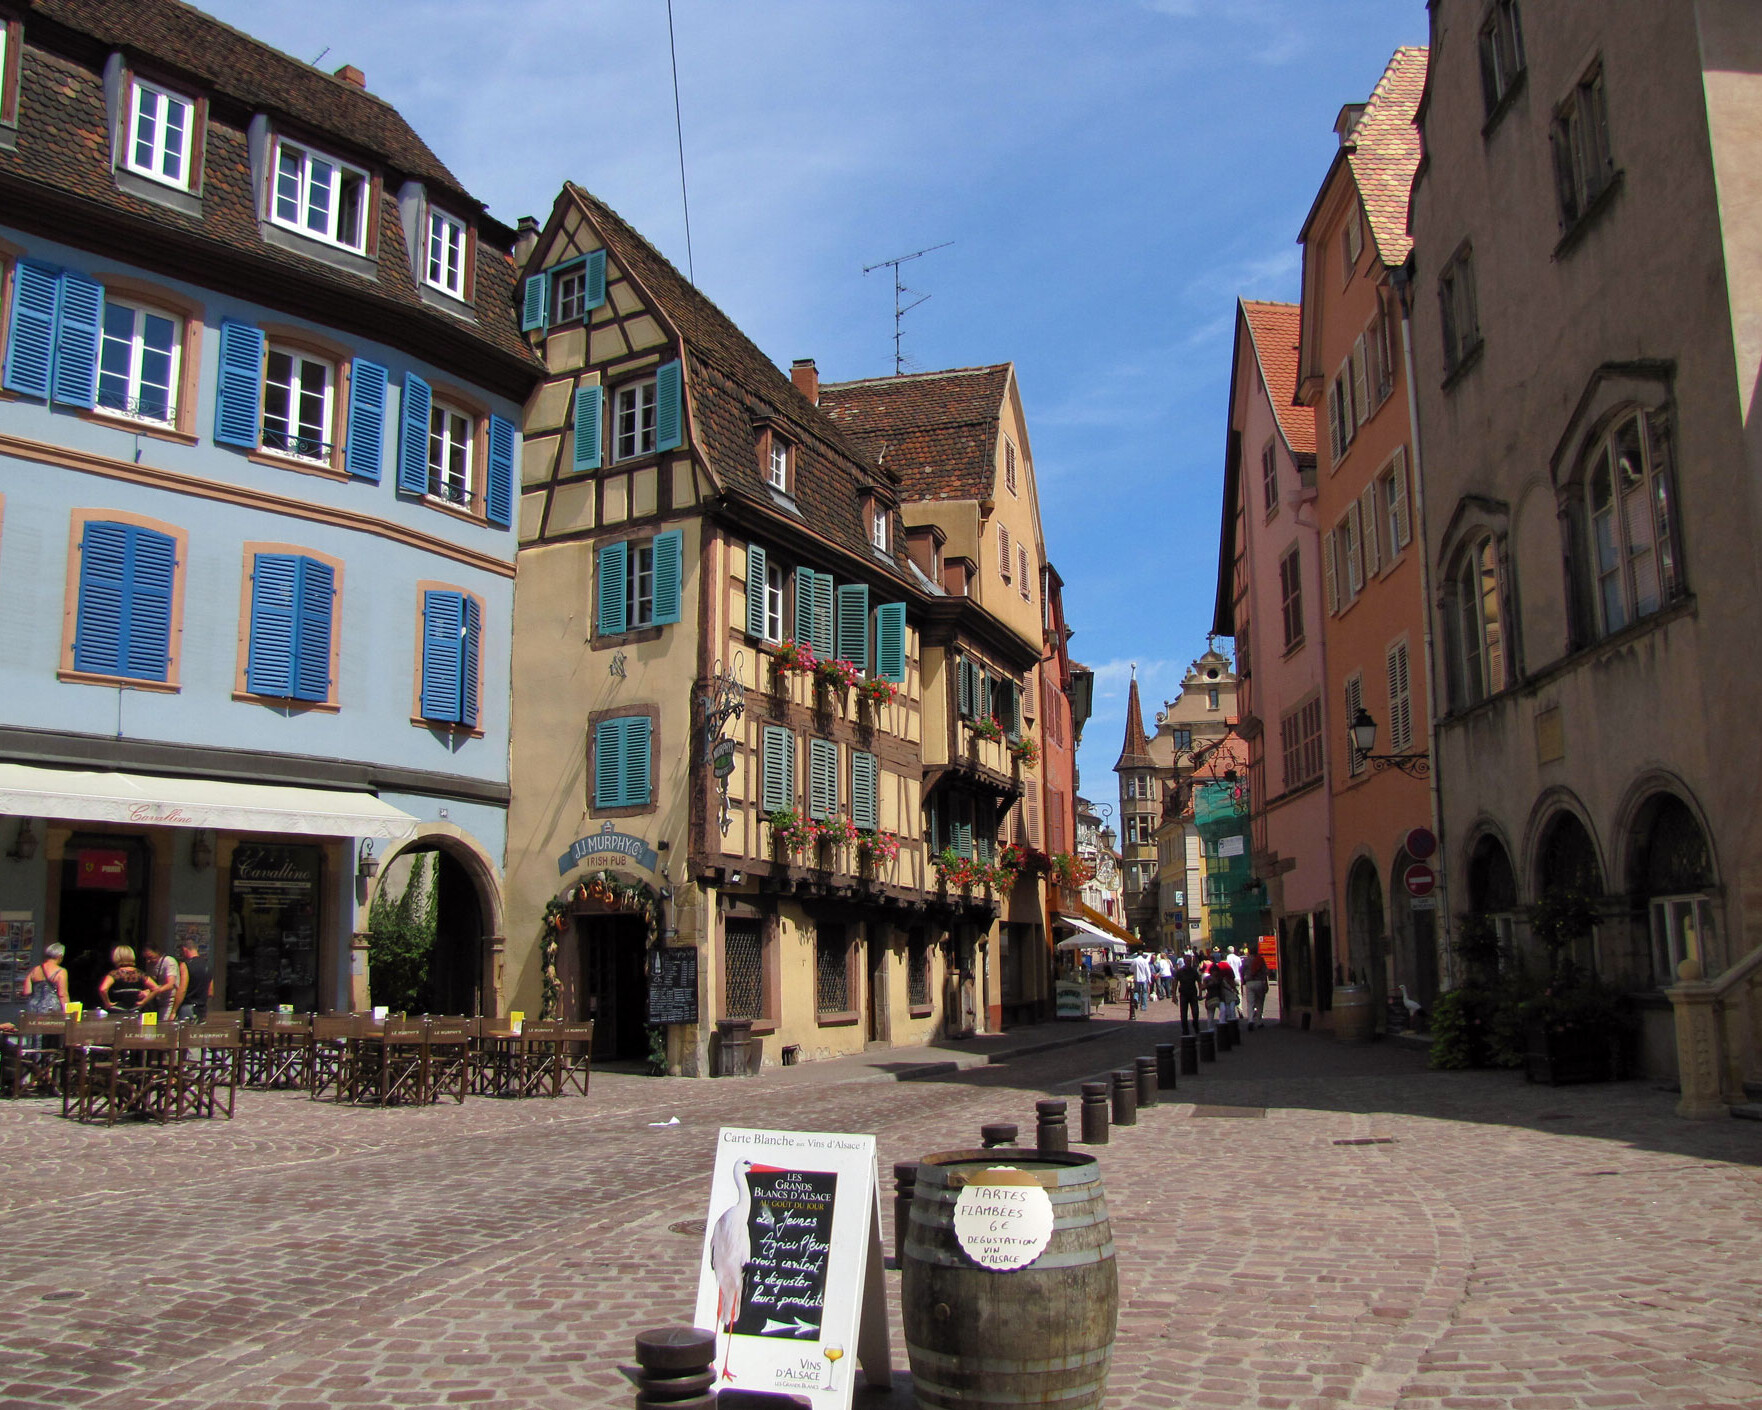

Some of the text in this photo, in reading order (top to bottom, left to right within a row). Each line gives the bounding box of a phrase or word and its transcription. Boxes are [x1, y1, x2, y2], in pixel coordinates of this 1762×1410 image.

[128, 803, 192, 823] Cavallino
[237, 853, 311, 879] Cavallino
[587, 855, 627, 867] IRISH PUB
[724, 1132, 751, 1143] Carte
[754, 1133, 794, 1146] Blanche
[808, 1139, 825, 1148] Vins
[827, 1140, 860, 1150] d'Alsace
[787, 1173, 802, 1181] LES
[790, 1190, 832, 1201] D'ALSACE
[975, 1187, 1028, 1201] TARTES
[776, 1209, 818, 1237] Jeunes
[989, 1220, 997, 1231] 6
[760, 1232, 829, 1257] Agriculteurs
[968, 1236, 1038, 1246] DEGUSTATION
[782, 1251, 823, 1272] invitent
[981, 1254, 1020, 1263] D'ALSACE
[754, 1270, 761, 1282] à
[751, 1285, 824, 1309] leurs produits
